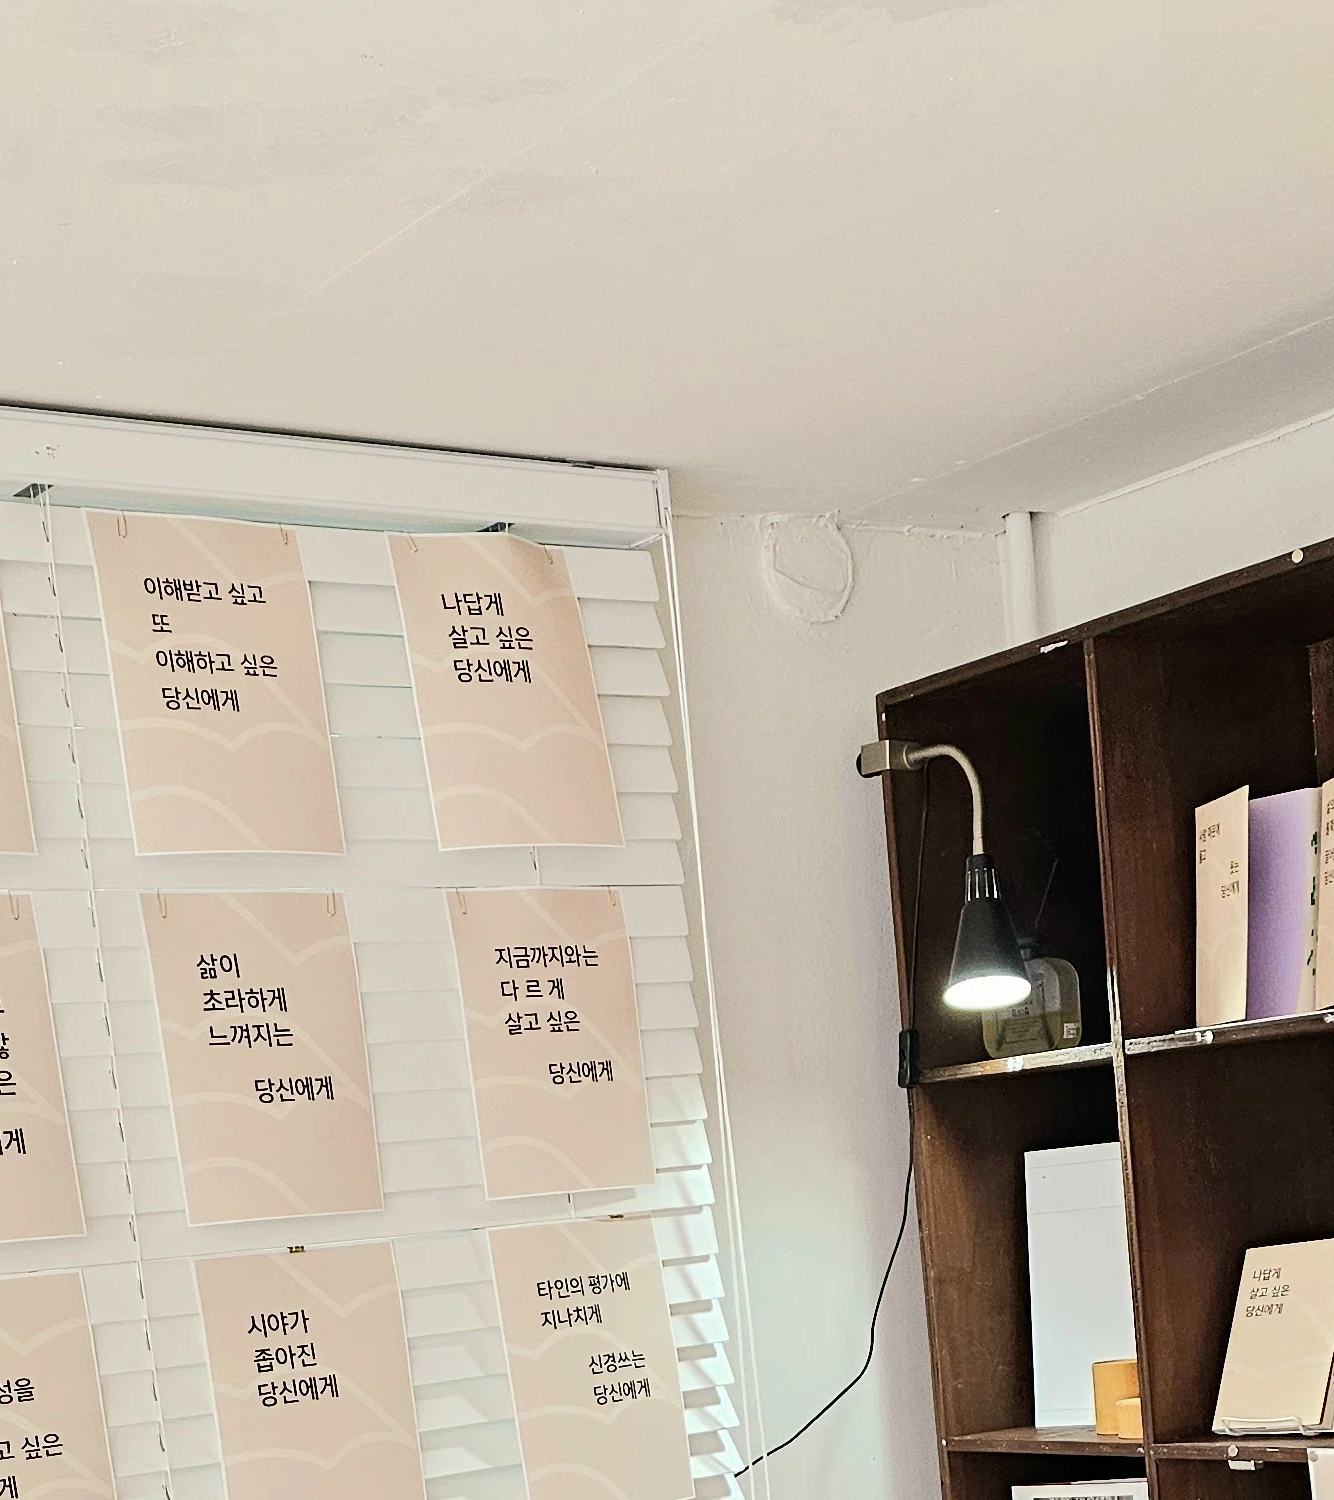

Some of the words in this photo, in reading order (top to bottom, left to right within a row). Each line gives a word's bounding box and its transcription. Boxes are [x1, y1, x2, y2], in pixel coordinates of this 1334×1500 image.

[143, 576, 223, 603] 이해받고
[227, 582, 267, 606] 싶고
[440, 591, 505, 617] 나답게
[151, 613, 173, 634] 또
[448, 624, 490, 650] 살고
[495, 625, 534, 651] 싶은
[155, 649, 236, 675] 이해하고
[240, 653, 278, 678] 싶은
[453, 658, 532, 684] 당신에게
[161, 686, 240, 713] 당신에게
[196, 953, 241, 980] 삶이
[494, 944, 599, 969] 지금까지와는
[202, 986, 288, 1014] 초라하게
[208, 1022, 294, 1049] 느껴지는
[504, 1011, 542, 1036] 살고
[546, 1010, 581, 1033] 싶은
[548, 1059, 614, 1086] 당신에게
[254, 1075, 335, 1104] 당신에게
[536, 1275, 585, 1301] 타인의
[587, 1271, 631, 1295] 평가에
[1252, 1267, 1282, 1282] 나답게
[1249, 1287, 1269, 1300] 살고
[1271, 1284, 1290, 1298] 싶은
[540, 1303, 603, 1330] 지나치게
[1245, 1302, 1284, 1318] 당신에게
[247, 1309, 310, 1339] 시야가
[253, 1342, 318, 1374] 좁아진
[588, 1349, 646, 1375] 신경쓰는
[257, 1373, 340, 1408] 당신에게
[593, 1377, 651, 1406] 당신에게
[20, 1433, 64, 1461] 싶은
